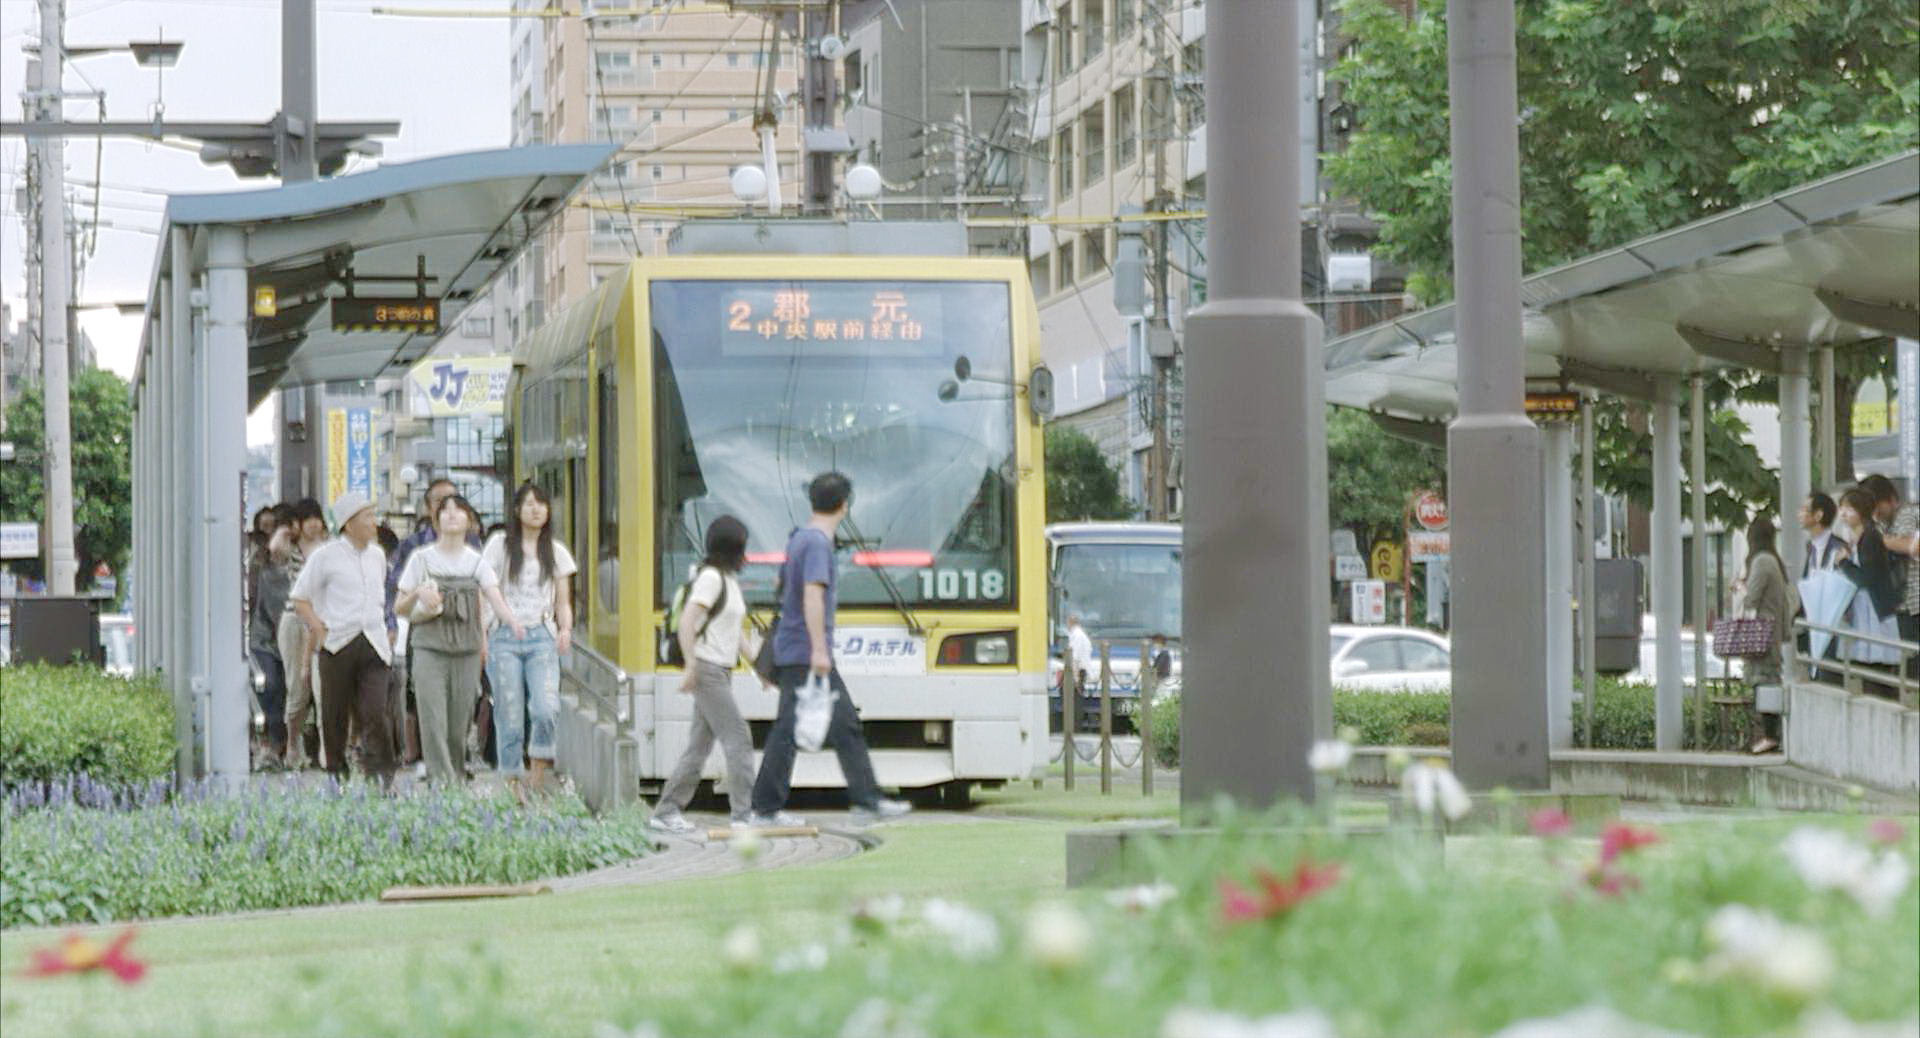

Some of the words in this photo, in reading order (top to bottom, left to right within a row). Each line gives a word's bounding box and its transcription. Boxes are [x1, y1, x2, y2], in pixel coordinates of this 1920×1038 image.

[728, 299, 752, 332] 2
[756, 319, 923, 342] 中央駅前経由
[429, 363, 470, 408] JJ
[919, 568, 1005, 600] 1018
